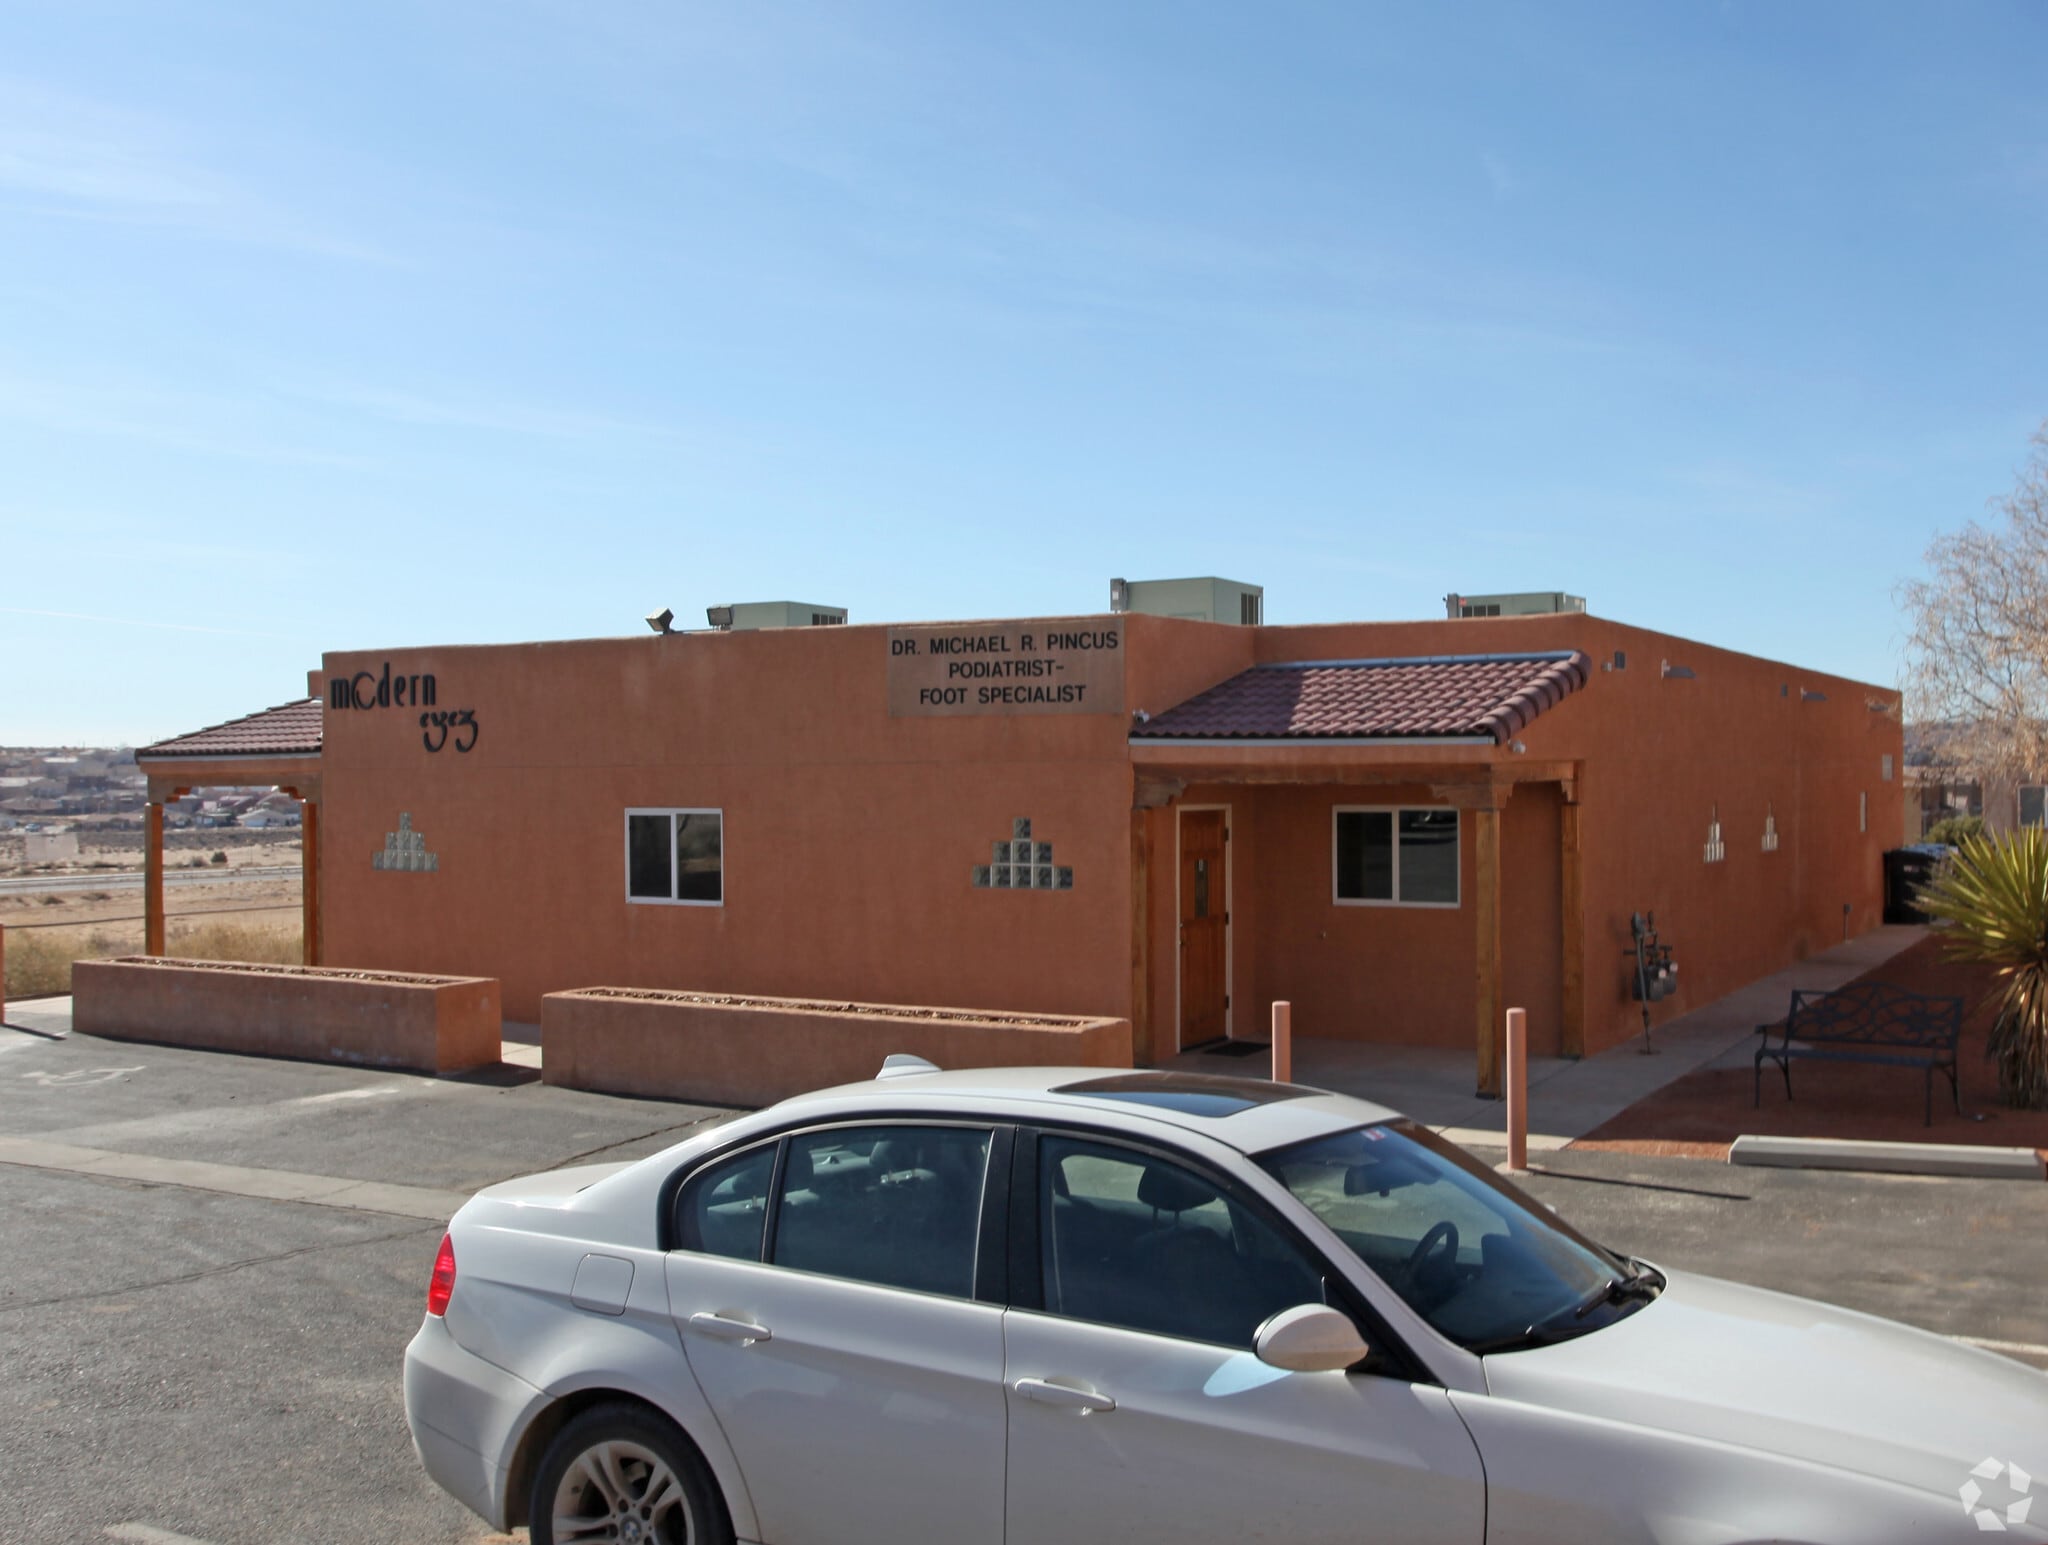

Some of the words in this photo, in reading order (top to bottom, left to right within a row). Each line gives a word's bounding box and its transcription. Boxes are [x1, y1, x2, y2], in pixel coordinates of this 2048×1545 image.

[892, 639, 921, 656] DR.
[930, 636, 1011, 655] MICHAEL
[1021, 634, 1037, 651] R.
[1047, 631, 1119, 650] PINCUS
[949, 659, 1064, 679] PODIATRIST-
[920, 687, 968, 705] FOOT
[978, 684, 1086, 704] SPECIALIST
